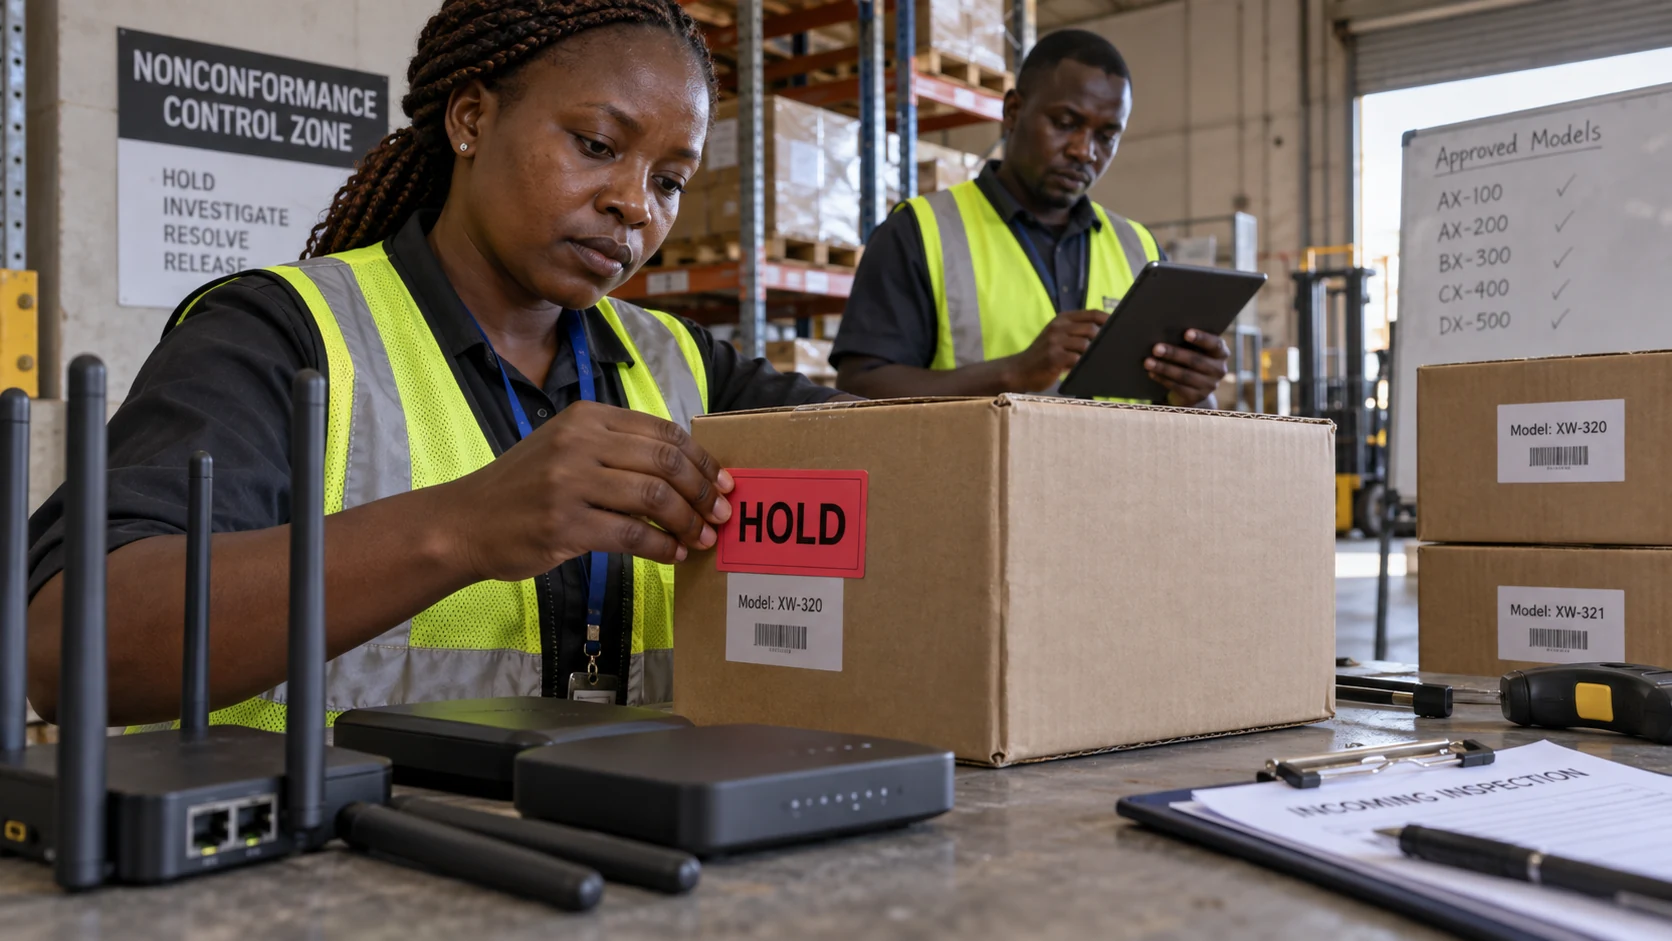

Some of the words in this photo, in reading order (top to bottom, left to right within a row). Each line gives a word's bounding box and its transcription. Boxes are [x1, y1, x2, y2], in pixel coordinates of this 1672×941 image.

[133, 49, 378, 119] NONCONFORMANCE
[163, 95, 284, 143] CONTROL
[290, 115, 353, 152] ZONE
[1435, 132, 1518, 173] Approved
[1531, 120, 1602, 151] Models
[163, 168, 216, 192] HOLD
[1437, 183, 1503, 212] AX-100
[163, 197, 289, 227] INVESTIGATE
[164, 224, 250, 250] RESOLVE
[1437, 214, 1508, 243] AX-200
[1439, 246, 1511, 273] BX-300
[1438, 278, 1510, 304] CX-400
[1439, 311, 1511, 336] DX-500
[1510, 422, 1552, 437] Model:
[1556, 420, 1608, 435] XW-320
[739, 501, 846, 546] HOLD
[738, 594, 774, 611] Model:
[778, 596, 823, 613] XW-320
[1510, 603, 1551, 618] Model:
[1556, 605, 1605, 620] XW-321
[1287, 790, 1440, 819] INCOMING
[1436, 767, 1590, 800] INSPECTION
